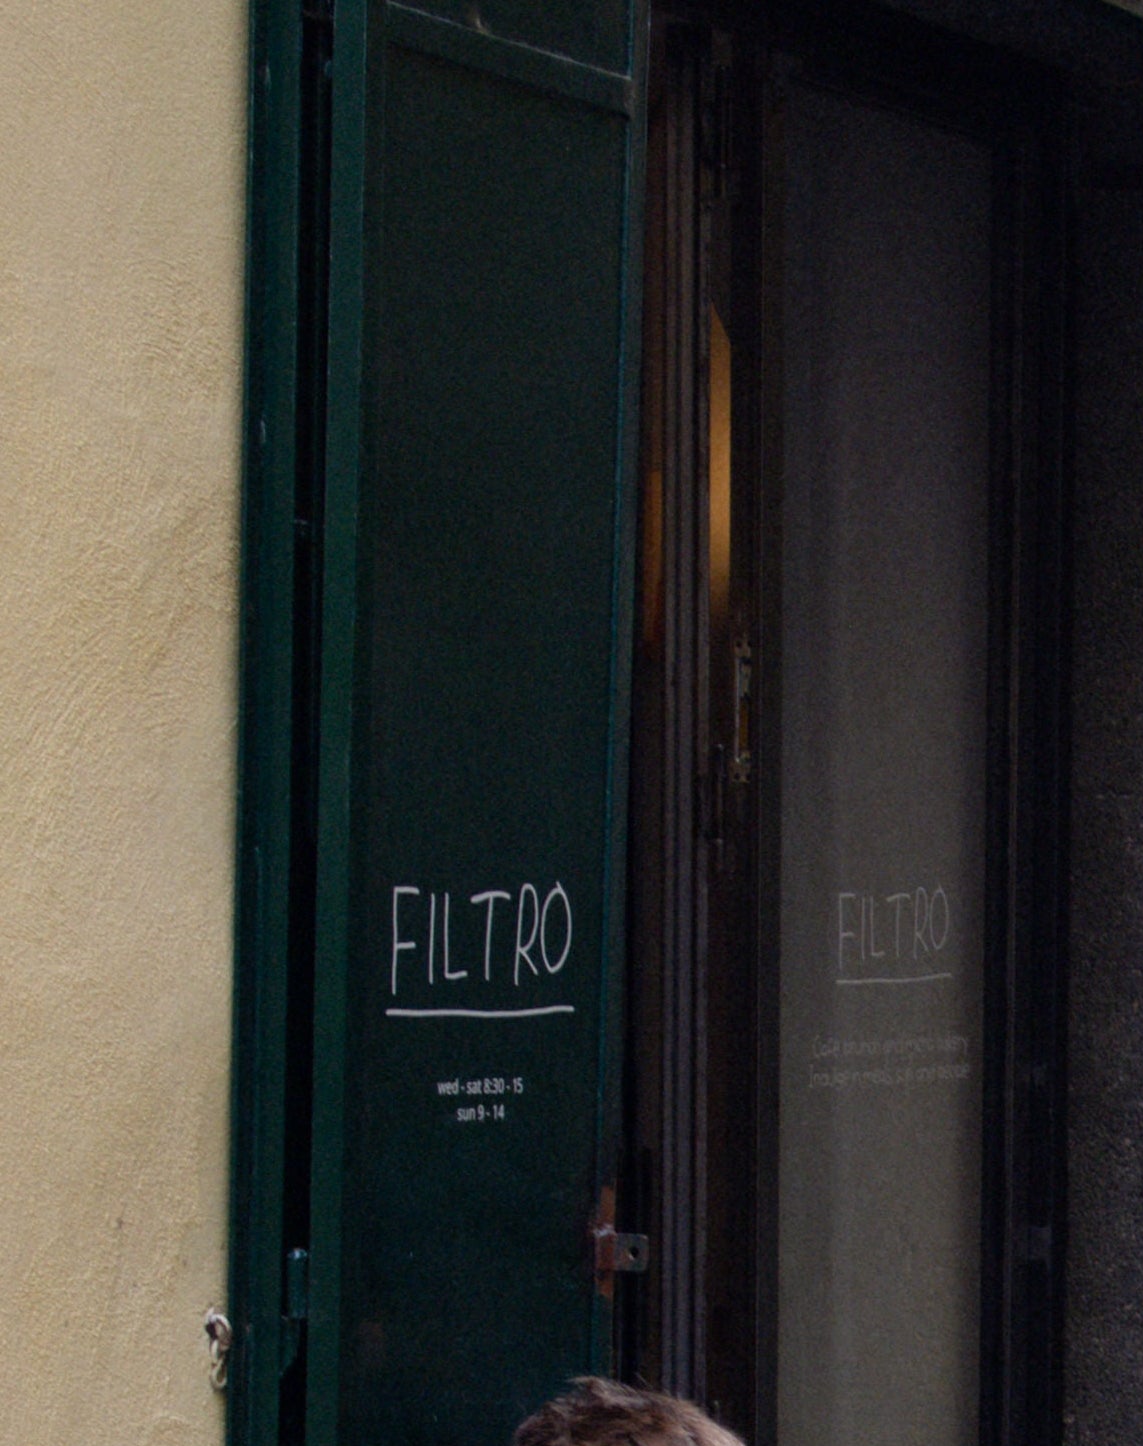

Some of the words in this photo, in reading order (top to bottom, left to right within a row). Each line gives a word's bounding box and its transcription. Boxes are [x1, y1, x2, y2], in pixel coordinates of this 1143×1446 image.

[391, 881, 573, 996] FILTRO
[837, 882, 951, 970] FILTRO
[437, 1078, 459, 1095] wed
[466, 1081, 482, 1094] sat
[513, 1077, 523, 1094] 15
[457, 1108, 476, 1122] sun
[477, 1103, 485, 1121] 9
[493, 1104, 505, 1121] 14
